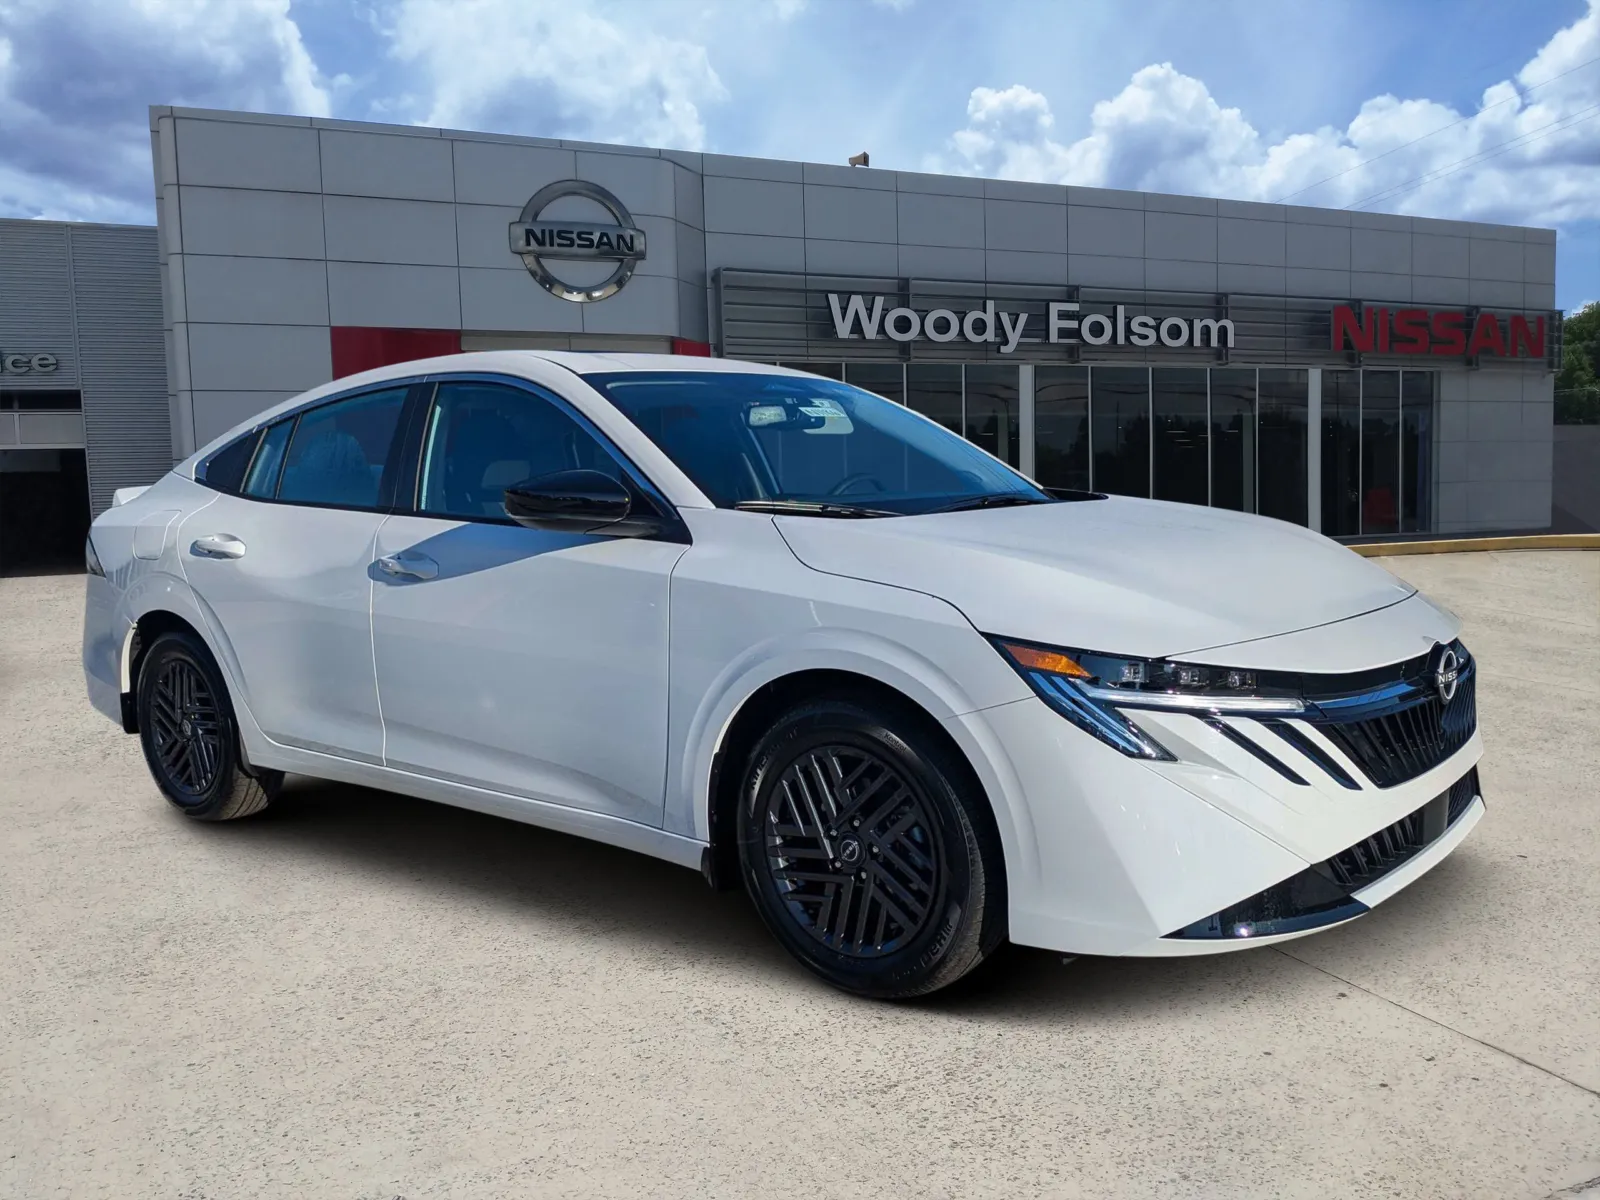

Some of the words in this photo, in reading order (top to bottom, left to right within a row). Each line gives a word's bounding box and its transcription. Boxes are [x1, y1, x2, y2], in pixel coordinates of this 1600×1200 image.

[525, 228, 634, 252] NISSAN
[828, 293, 1028, 353] Woody
[1048, 301, 1235, 348] Folsom
[1332, 305, 1545, 358] NISSAN
[0, 353, 57, 374] ce
[1438, 670, 1458, 683] NISS
